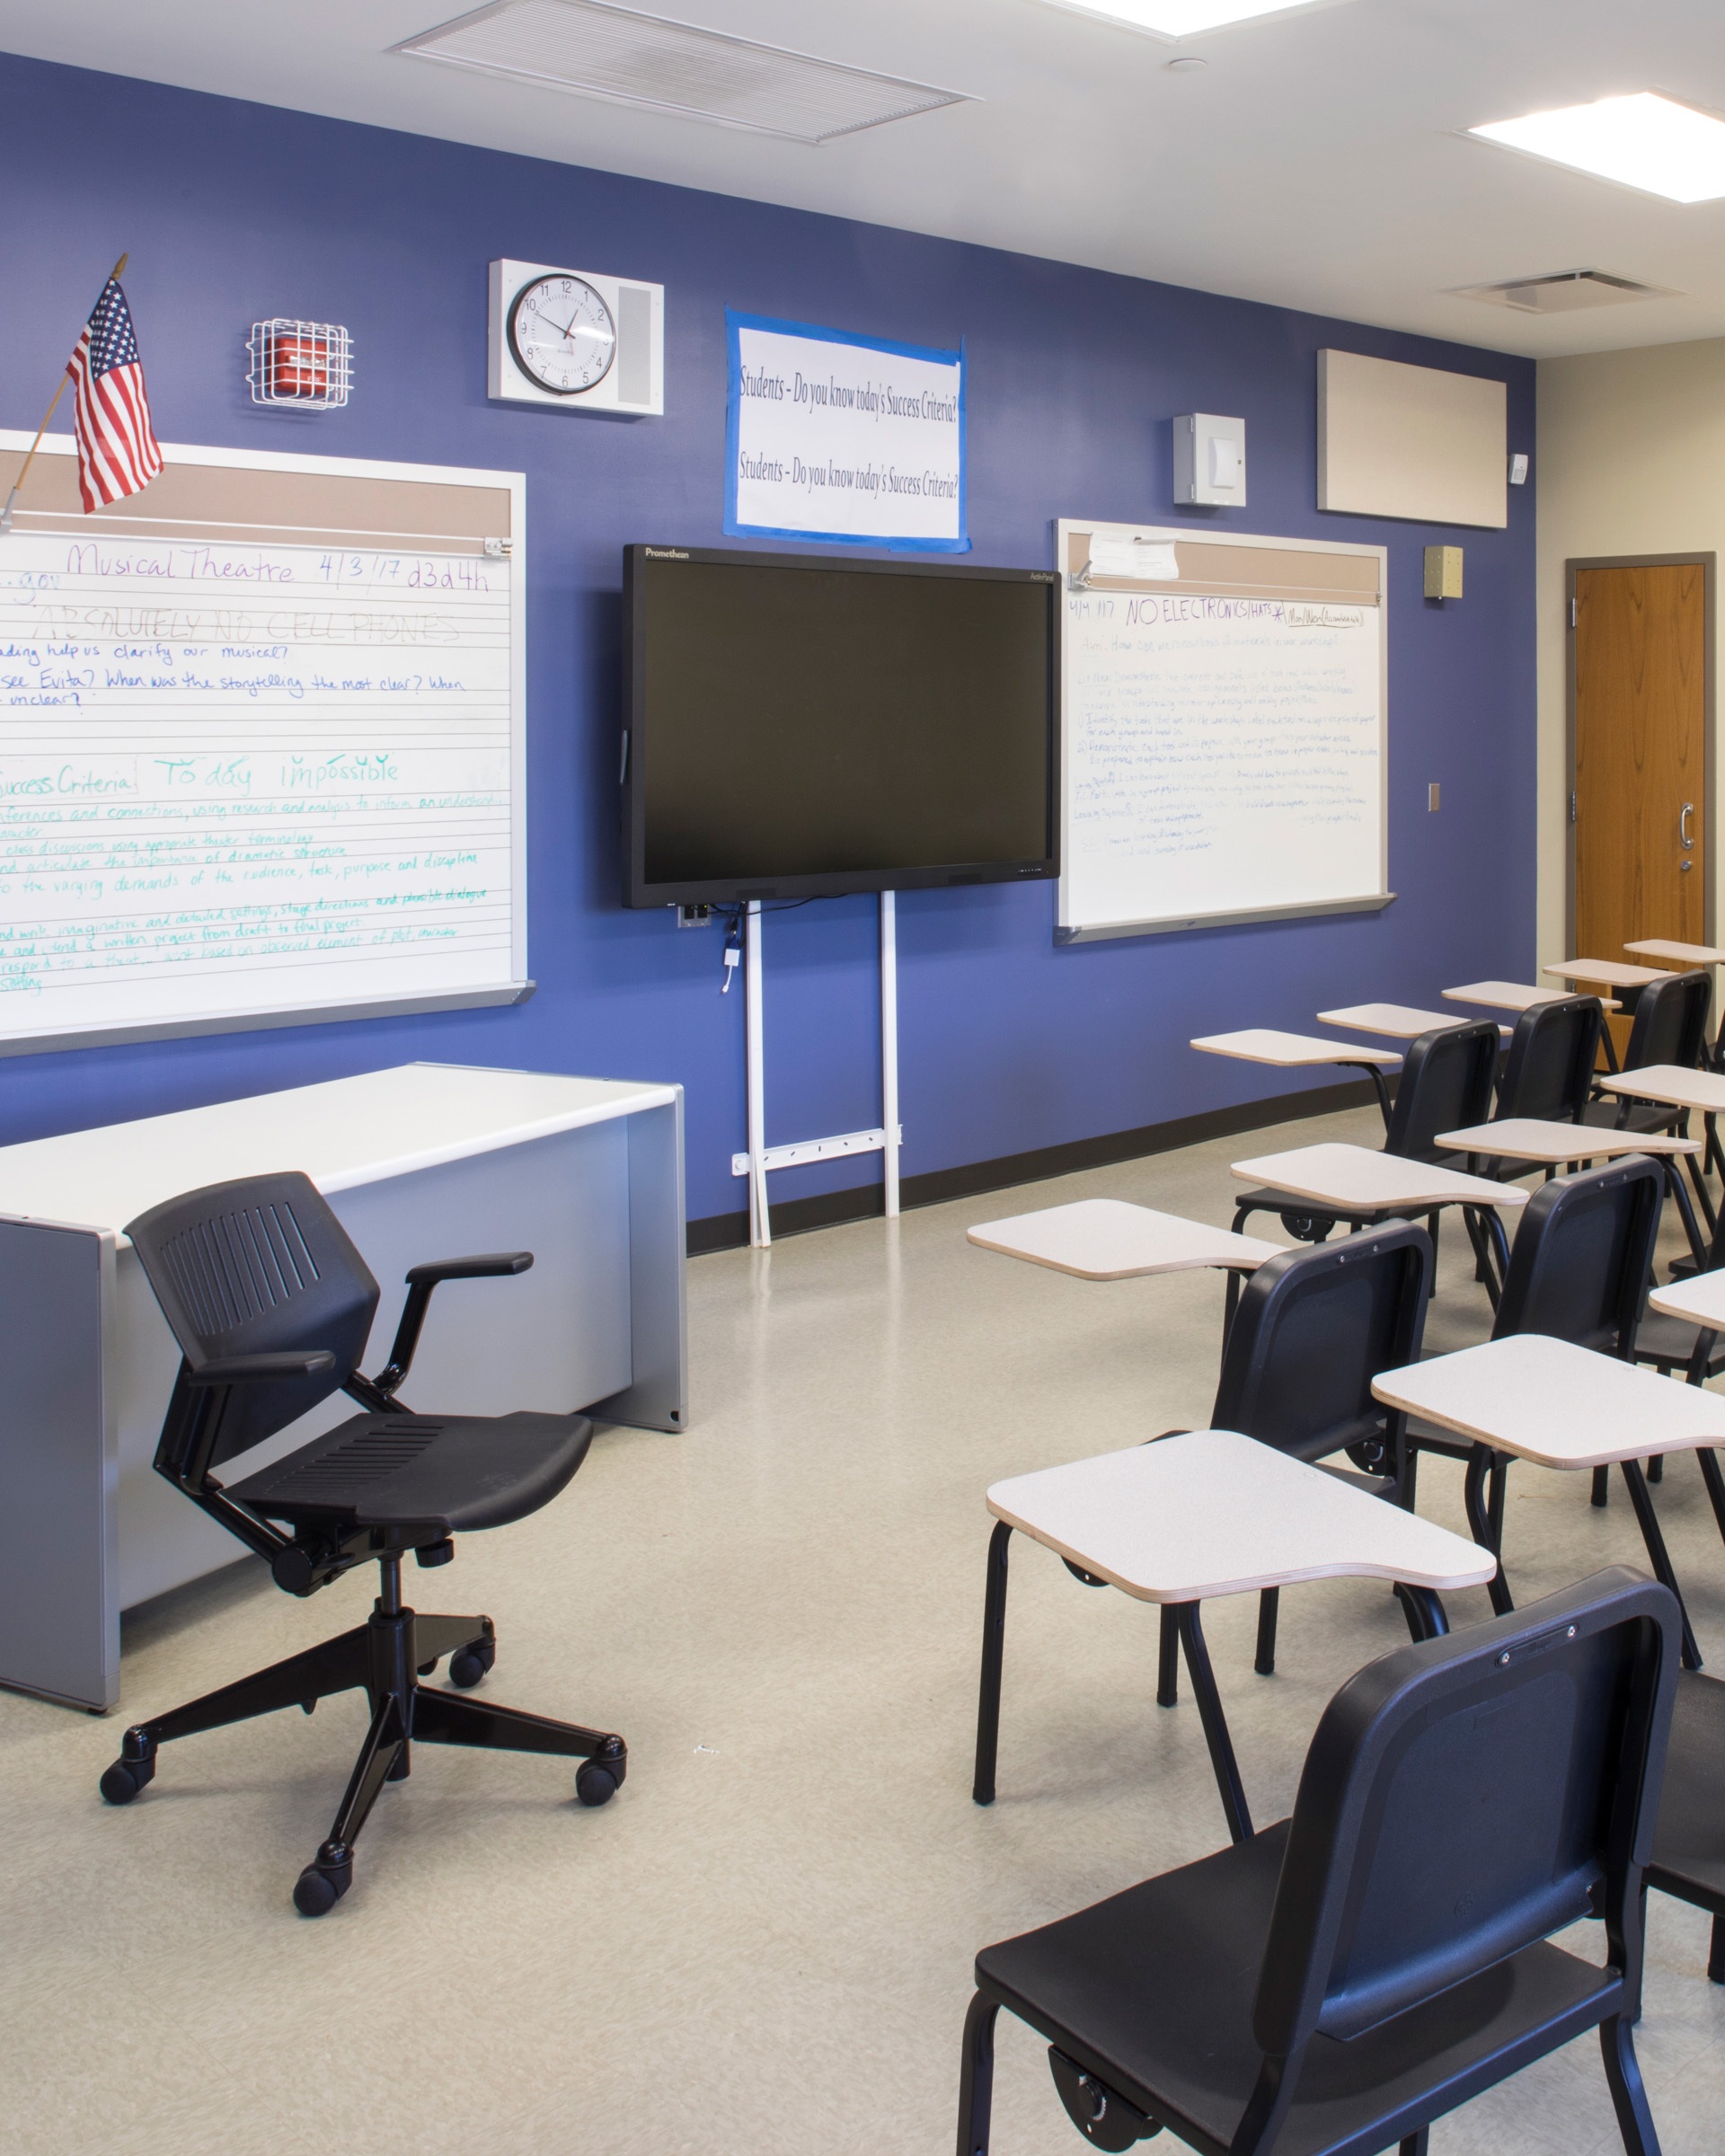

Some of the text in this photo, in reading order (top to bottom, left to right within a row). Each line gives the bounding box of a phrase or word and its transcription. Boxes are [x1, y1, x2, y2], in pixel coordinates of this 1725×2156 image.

[541, 285, 549, 296] 11
[562, 280, 571, 294] 12
[584, 290, 588, 302] 1
[525, 298, 536, 311] 10
[597, 309, 604, 321] 2
[521, 322, 527, 334] 9
[527, 348, 533, 360] 8
[596, 358, 602, 368] 4
[541, 366, 547, 378] 7
[582, 372, 588, 384] 5
[562, 376, 568, 388] 6
[740, 366, 783, 401] Students
[793, 372, 808, 403] Do
[809, 383, 827, 413] you
[830, 376, 854, 408] know
[856, 381, 885, 422] today's
[887, 385, 919, 418] Success
[921, 390, 956, 423] Criteria?
[740, 451, 782, 482] Students
[792, 456, 807, 484] Do
[808, 466, 826, 493] you
[829, 459, 854, 488] know
[855, 464, 886, 499] today's
[888, 467, 920, 495] Success
[922, 470, 958, 499] Criteria?
[646, 547, 689, 559] Promethean
[67, 543, 175, 578] Musical
[181, 548, 296, 583] Theatre
[1127, 599, 1158, 625] NO
[216, 610, 252, 641] NO
[268, 612, 345, 640] CELL
[349, 612, 460, 641] PHONES
[48, 643, 78, 660] help
[84, 648, 100, 657] us
[114, 644, 172, 666] clarify
[183, 648, 208, 658] our
[222, 643, 288, 663] musical?
[0, 668, 466, 698] see Evita? When was the storytelling the most clear? When
[11, 693, 80, 707] unclear?
[58, 764, 132, 794] Criteria
[70, 805, 98, 820] and
[192, 802, 226, 817] using
[232, 800, 277, 815] research
[281, 800, 304, 813] and
[356, 794, 369, 808] to
[6, 844, 34, 856] class
[39, 840, 105, 855] discussions
[112, 842, 138, 860] using
[102, 853, 131, 869] the
[205, 850, 219, 863] of
[22, 874, 46, 892] the
[54, 879, 102, 899] varying
[115, 873, 179, 891] demands
[191, 869, 204, 885] of
[215, 868, 234, 883] the
[344, 861, 392, 881] purpose
[398, 856, 417, 870] and
[58, 920, 137, 939] imaginative
[146, 915, 172, 929] and
[176, 908, 226, 924] detailed
[202, 927, 230, 942] from
